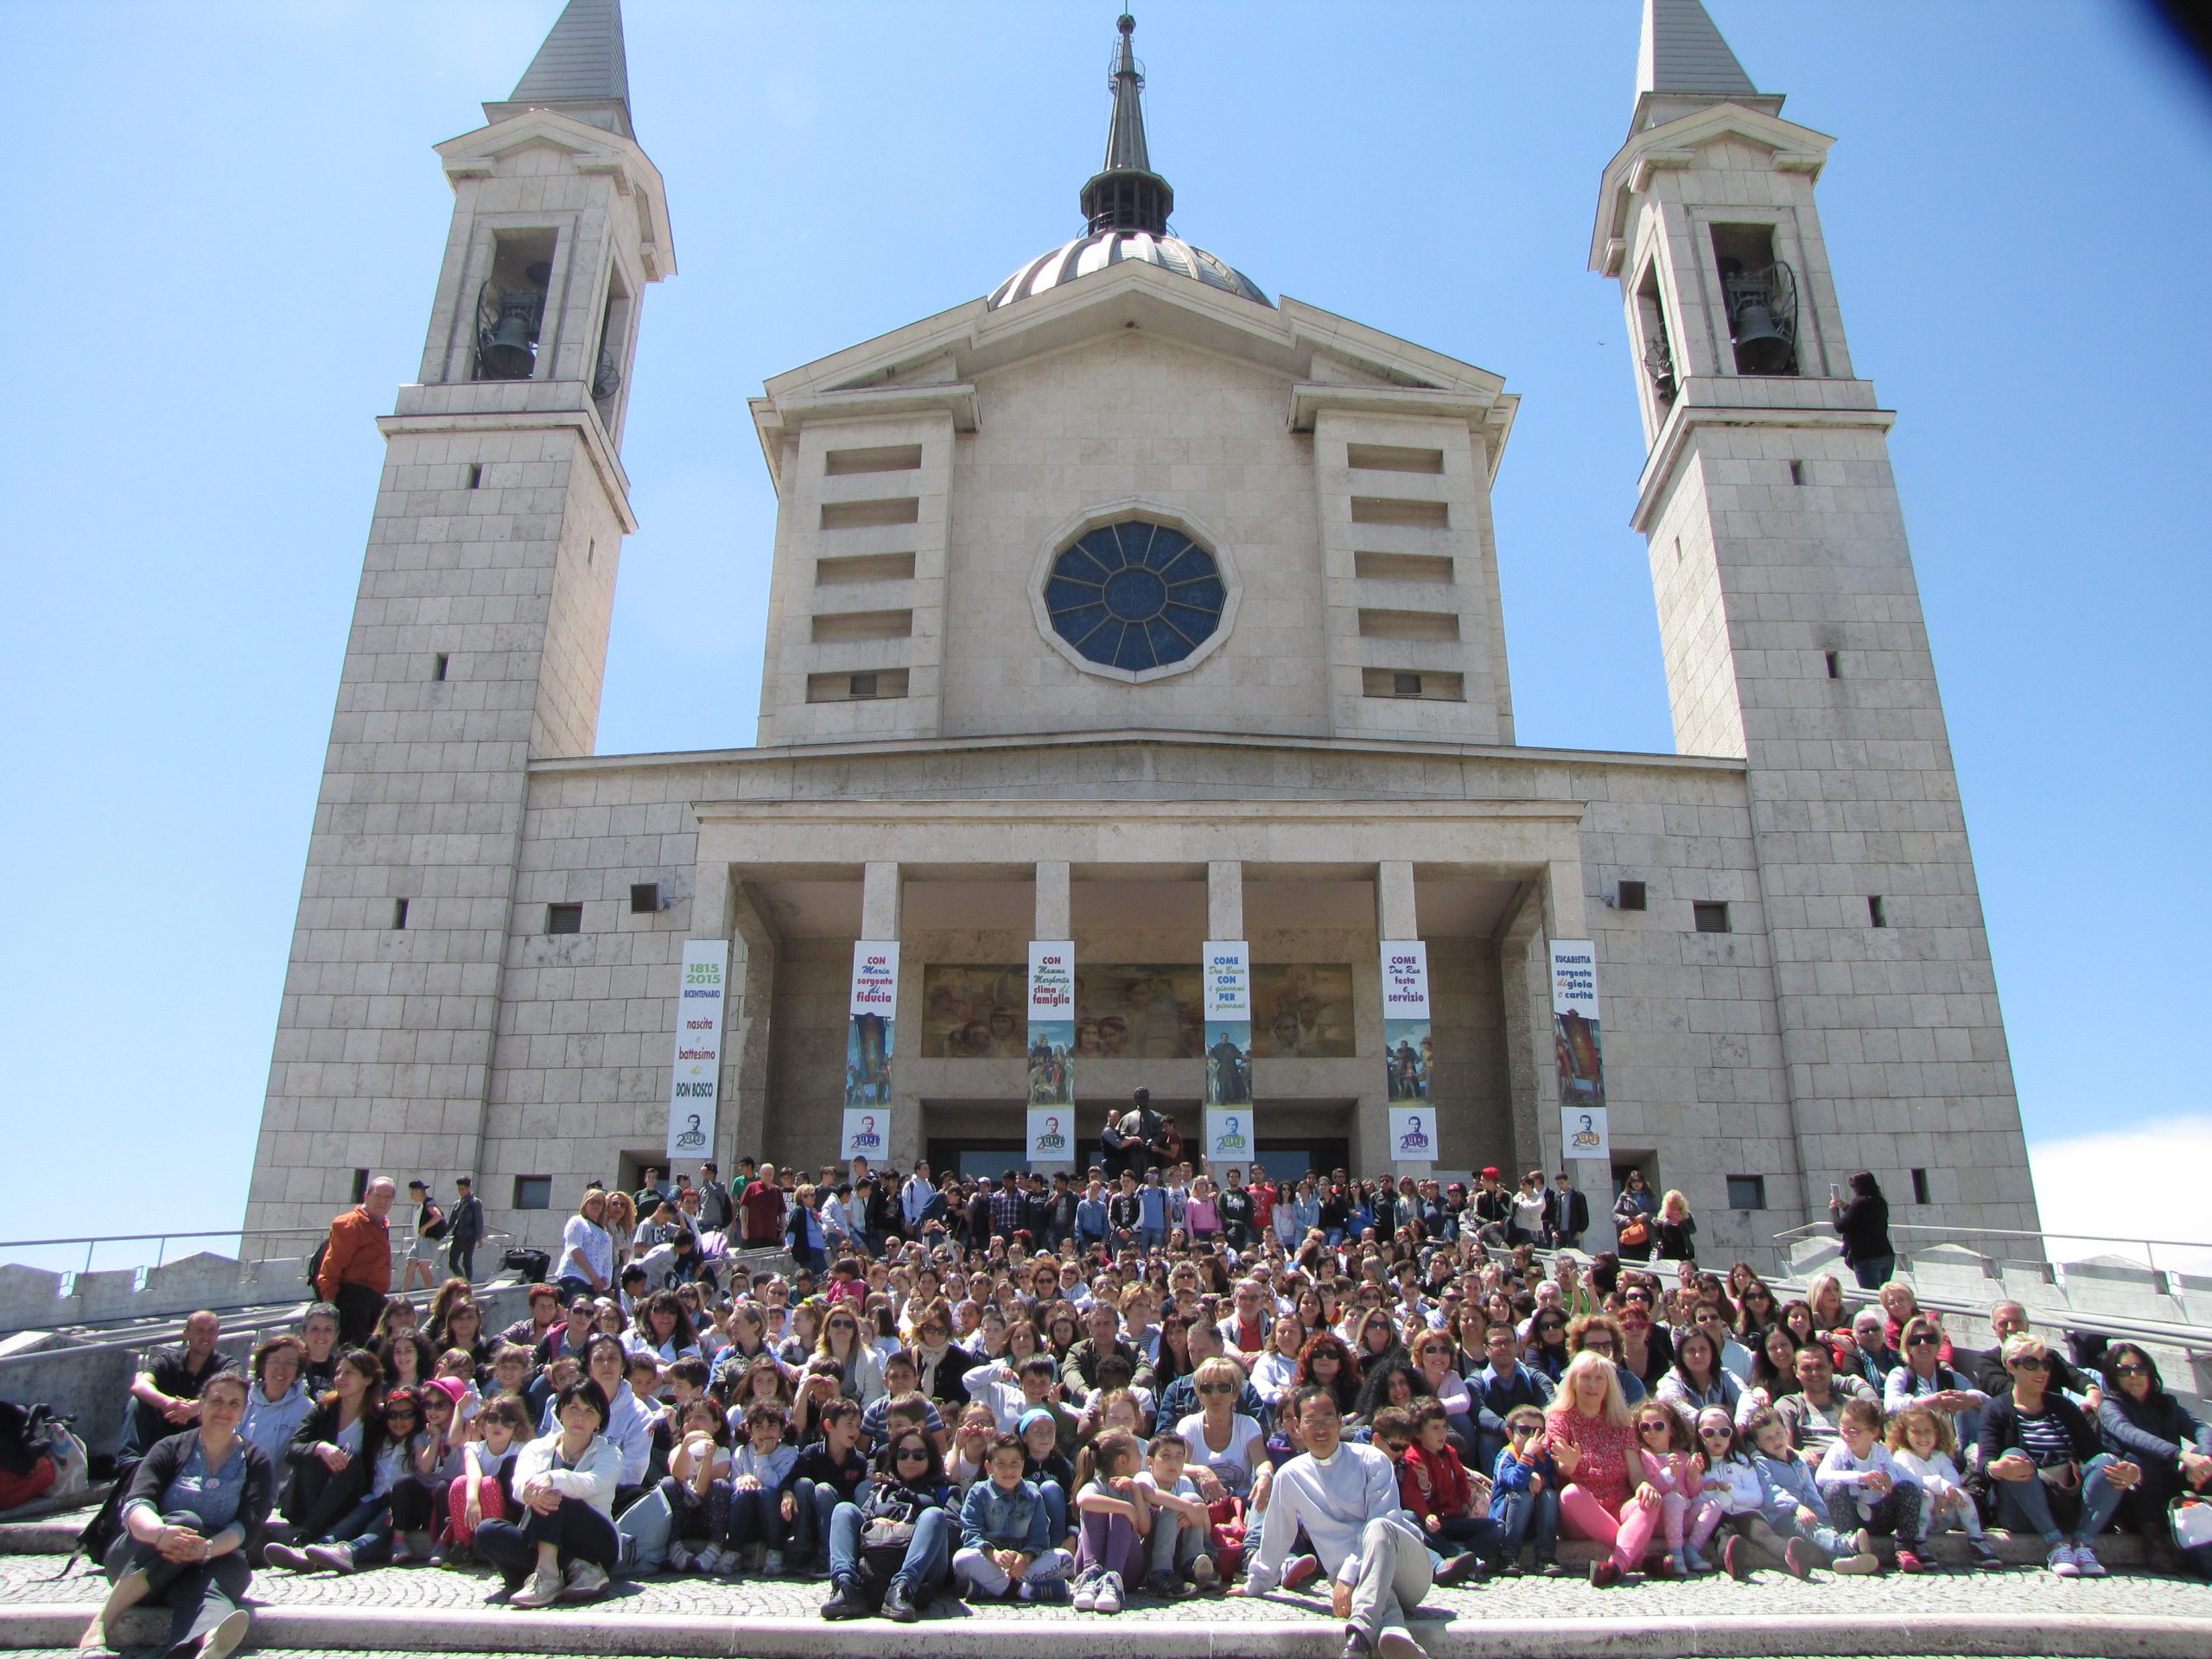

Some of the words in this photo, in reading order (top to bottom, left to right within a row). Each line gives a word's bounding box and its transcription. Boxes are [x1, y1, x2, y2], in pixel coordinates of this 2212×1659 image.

[1391, 956, 1416, 964] COME
[1554, 955, 1592, 964] EUCARISTIA
[689, 963, 720, 973] 1815
[861, 965, 890, 975] Maria
[1038, 965, 1065, 975] Mamma
[1209, 965, 1223, 975] Don
[1225, 965, 1245, 975] Bosco
[1389, 965, 1402, 974] Don
[1406, 965, 1421, 975] Rua
[685, 974, 721, 983] 2015
[1556, 969, 1592, 978] sorgente
[857, 977, 893, 987] sorgente
[1033, 975, 1070, 986] Margherita
[1217, 976, 1236, 984] CON
[1557, 977, 1567, 988] di
[1567, 979, 1592, 989] gioia
[683, 989, 721, 998] BICENTENARIO
[868, 985, 880, 995] di
[1033, 985, 1057, 994] clima
[1059, 984, 1070, 994] di
[1215, 985, 1245, 995] giovani
[856, 991, 892, 1002] fiducia
[1033, 993, 1070, 1007] famiglia
[1388, 991, 1424, 1002] servizio
[1565, 990, 1593, 1000] carità
[1215, 1002, 1246, 1011] giovani
[687, 1017, 713, 1029] nascita
[678, 1046, 715, 1060] battesimo
[676, 1082, 691, 1096] DON
[691, 1082, 714, 1097] BOSCO
